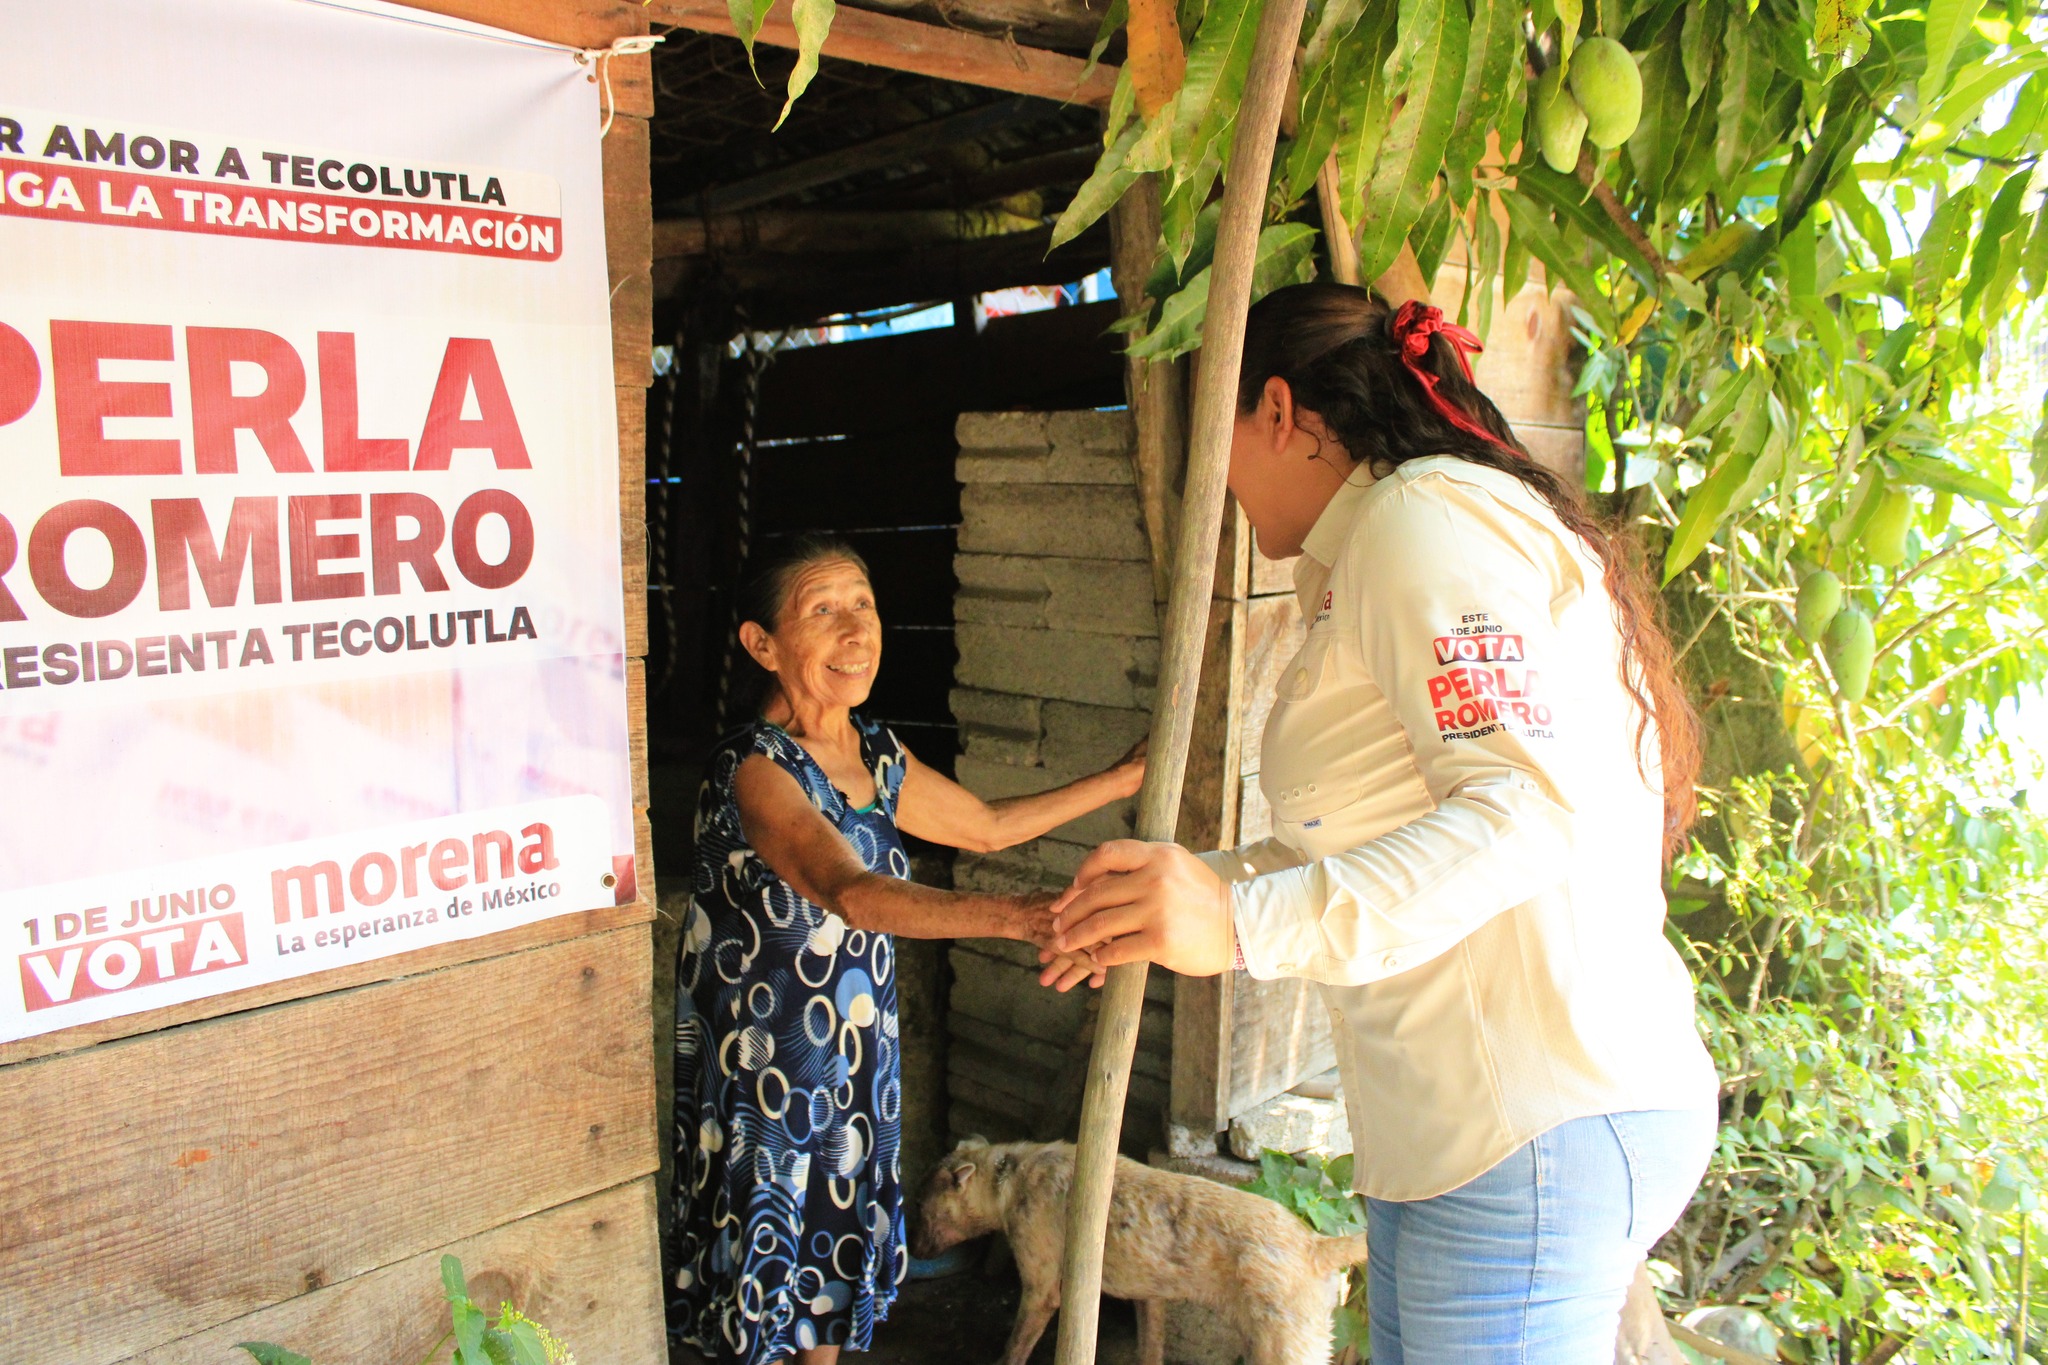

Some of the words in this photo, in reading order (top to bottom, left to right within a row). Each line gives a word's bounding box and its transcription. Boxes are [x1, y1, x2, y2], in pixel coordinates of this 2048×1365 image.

[43, 124, 199, 174] AMOR
[215, 147, 249, 180] A
[262, 152, 506, 206] TECOLUTLA
[99, 180, 162, 220] LA
[174, 190, 554, 253] TRANSFORMACIÓN
[0, 488, 535, 622] OMERO
[0, 622, 274, 690] ESIDENTA
[282, 605, 538, 662] TECOLUTLA
[1434, 637, 1523, 663] VOTA
[1450, 628, 1456, 636] 1
[1456, 627, 1470, 636] DE
[1472, 625, 1503, 635] JUNIO
[1461, 613, 1489, 624] ESTE
[1435, 698, 1552, 732] ROMERO
[272, 821, 559, 925] morena
[23, 918, 41, 946] 1
[54, 906, 110, 941] DE
[120, 884, 236, 930] JUNIO
[276, 934, 306, 957] La
[315, 907, 438, 949] esperanza
[446, 896, 473, 920] de
[481, 881, 561, 911] México
[25, 921, 243, 1004] VOTA
